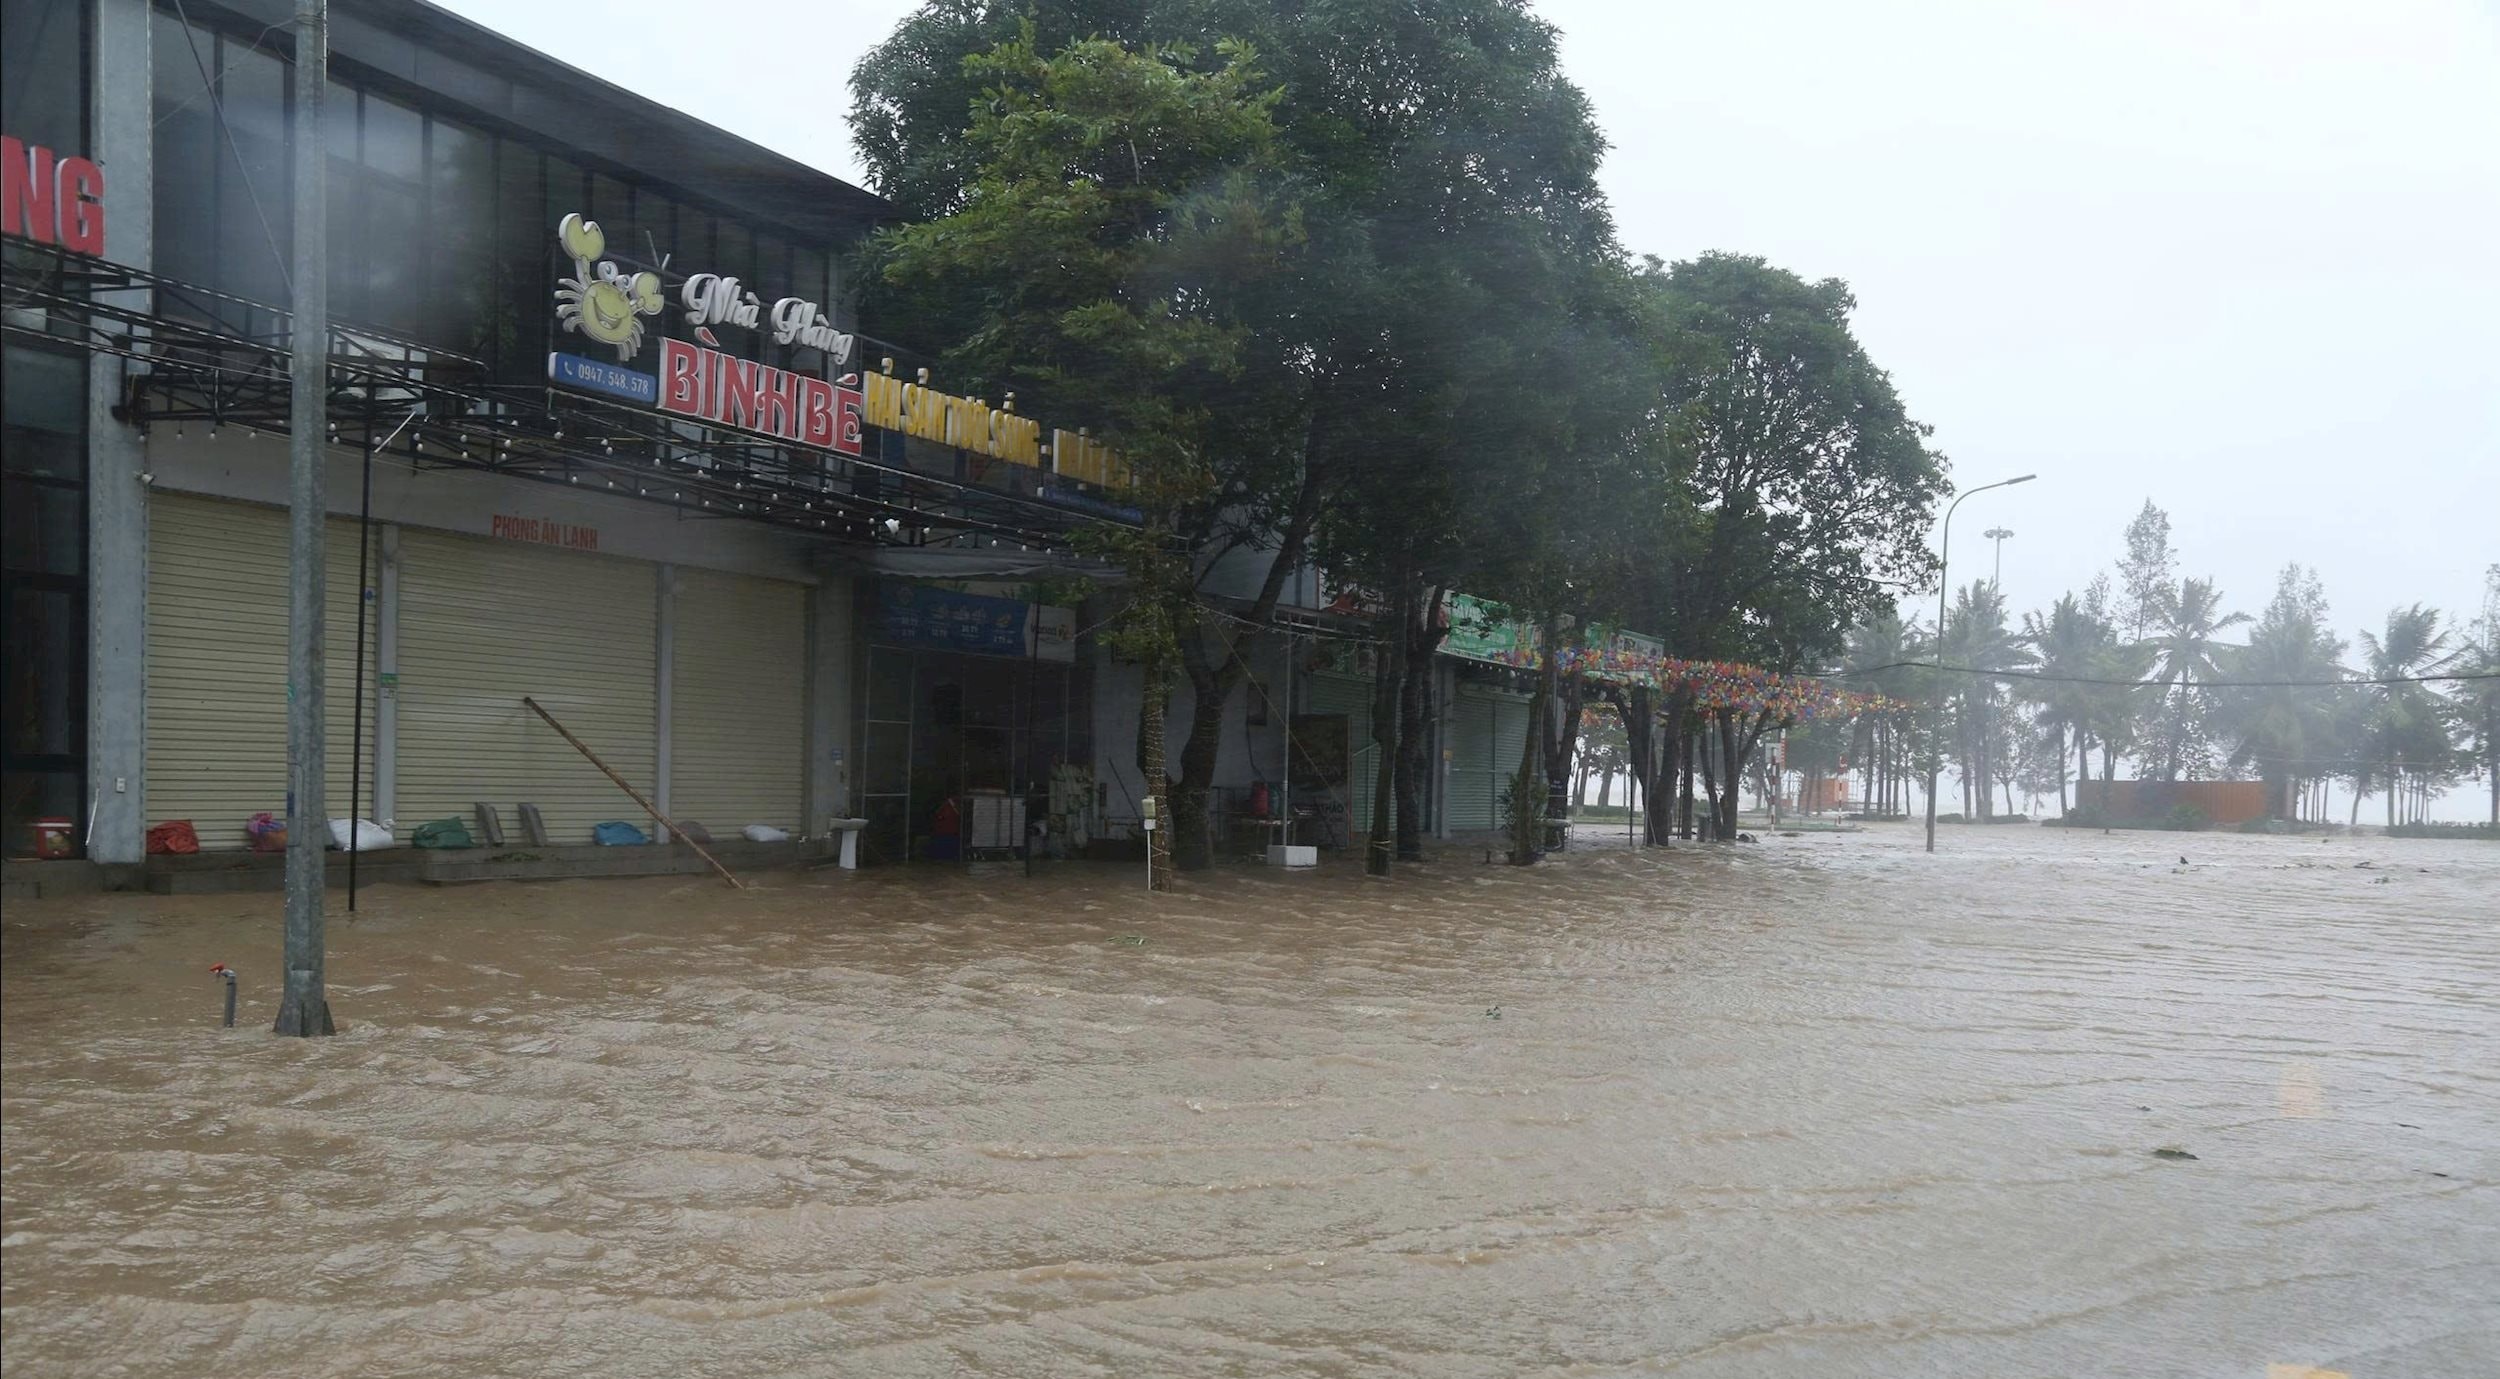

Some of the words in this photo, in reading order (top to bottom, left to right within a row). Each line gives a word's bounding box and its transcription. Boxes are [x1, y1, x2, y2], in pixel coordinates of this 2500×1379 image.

[682, 273, 760, 329] Nhà
[631, 374, 649, 395] 578
[658, 326, 799, 443] BÌNH
[801, 373, 863, 456] BÉ
[862, 357, 903, 432] HẢI
[901, 367, 947, 444] SẢN
